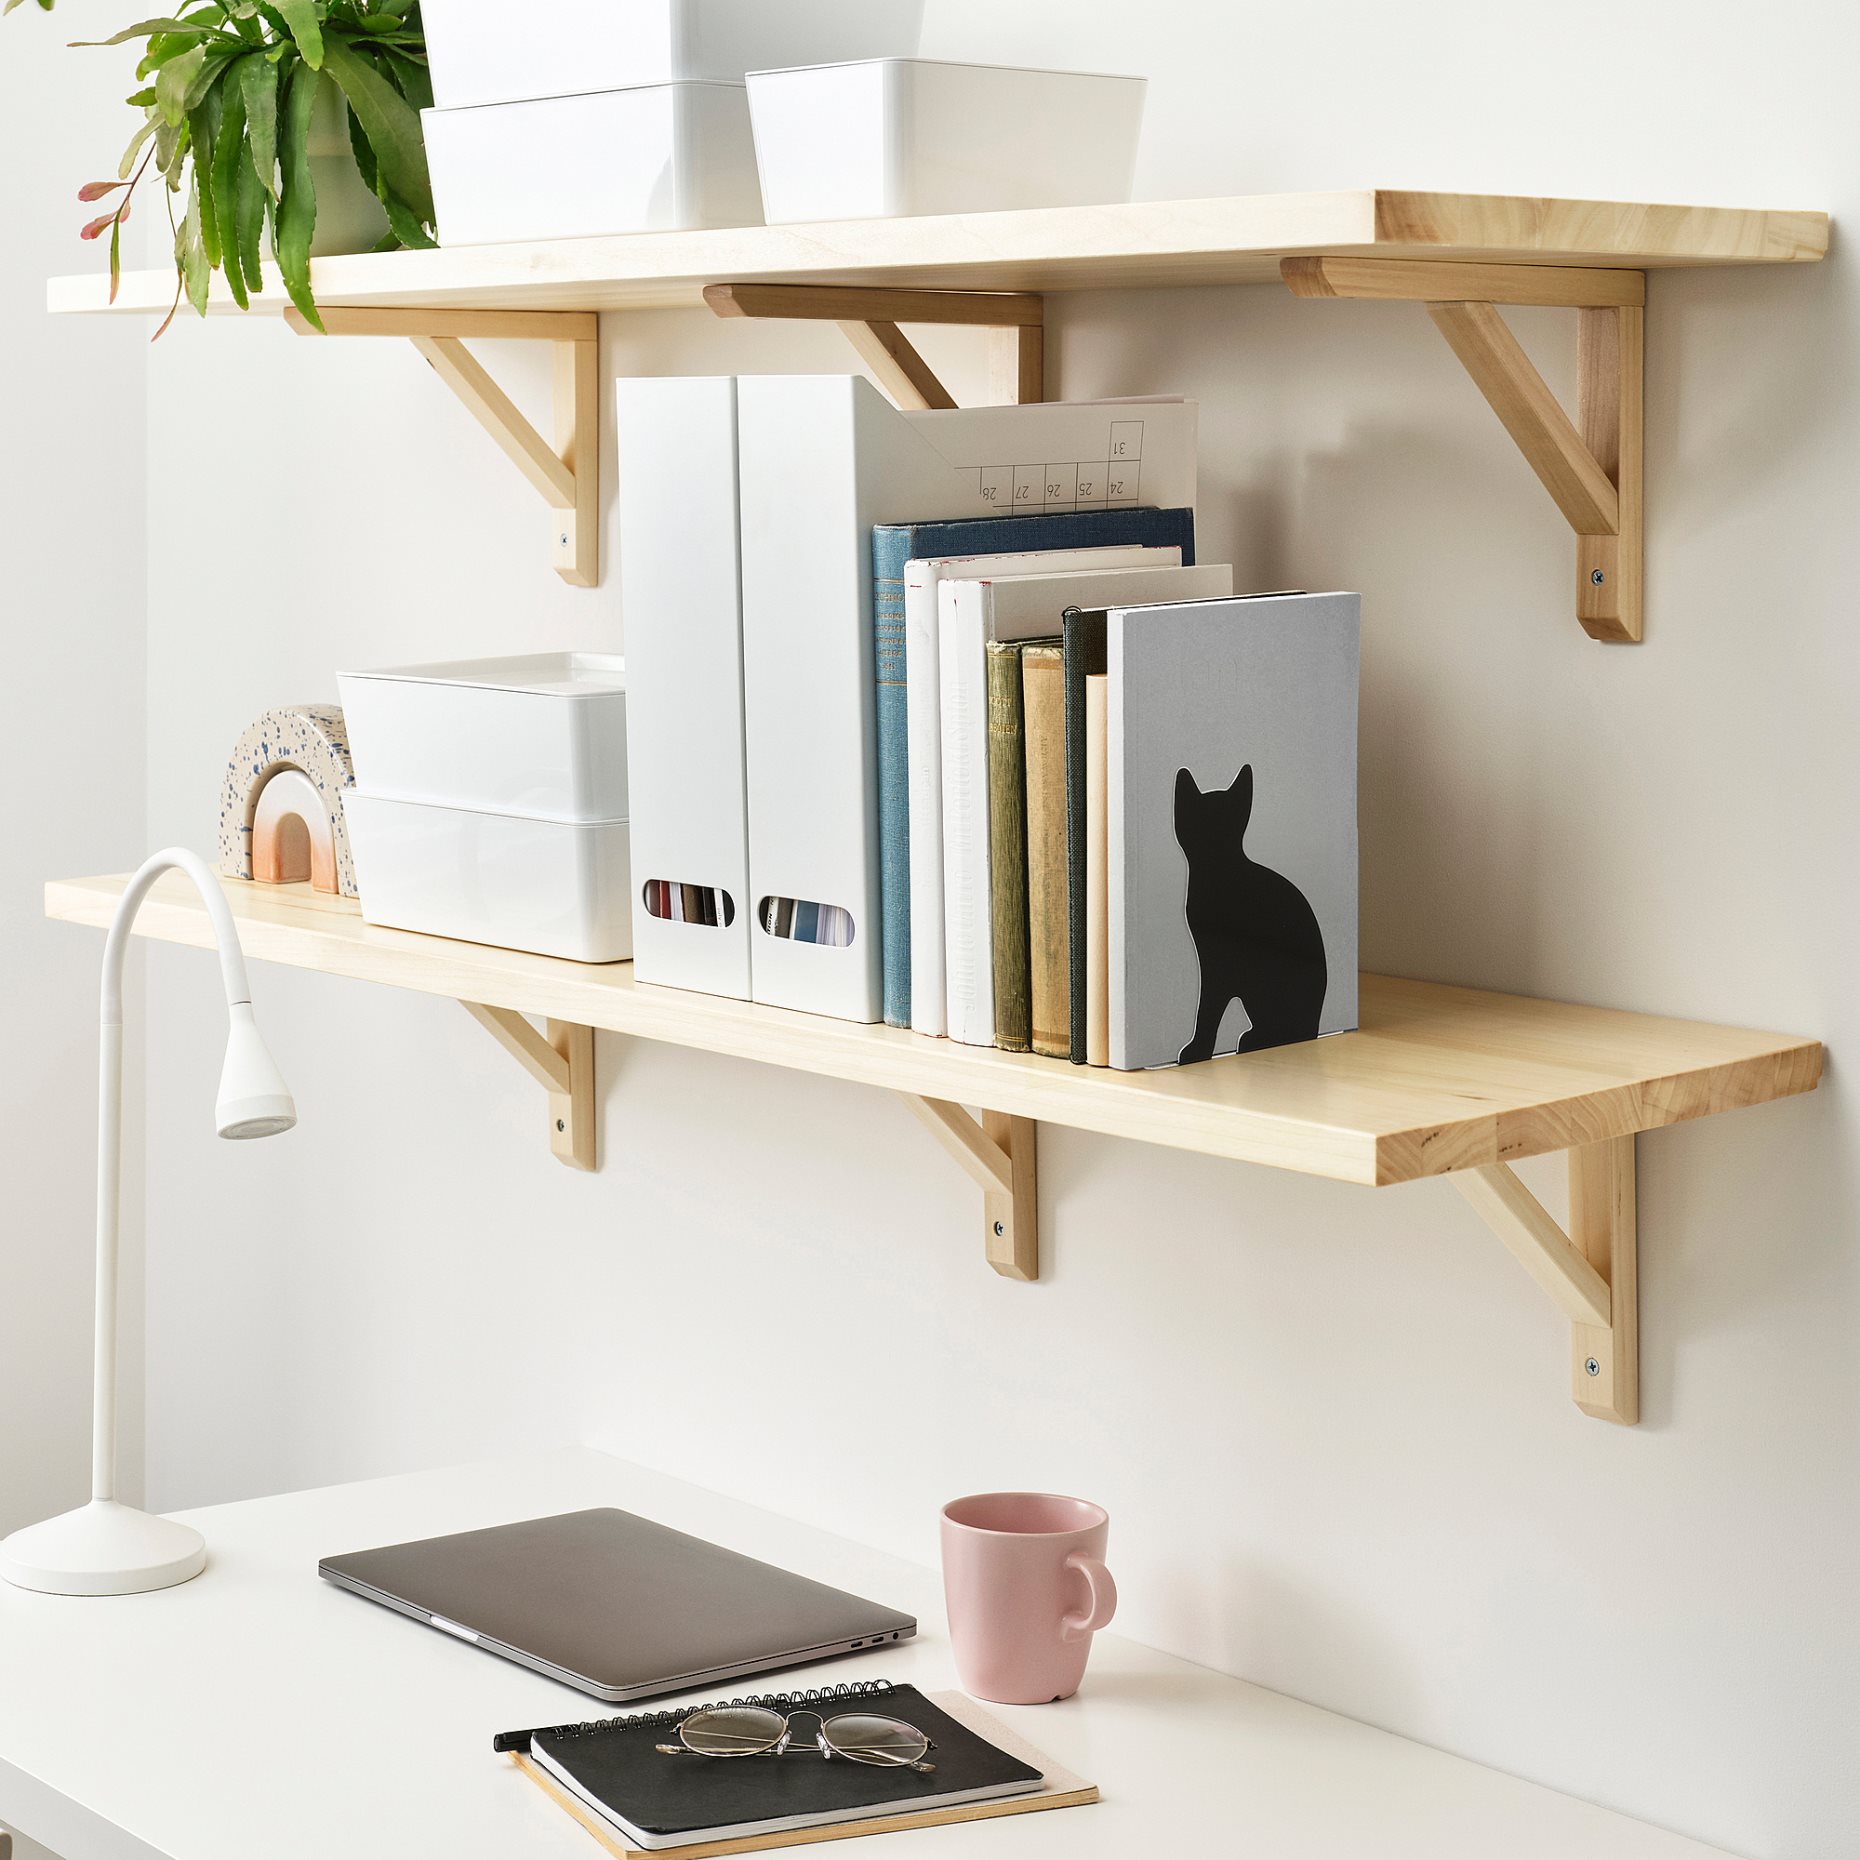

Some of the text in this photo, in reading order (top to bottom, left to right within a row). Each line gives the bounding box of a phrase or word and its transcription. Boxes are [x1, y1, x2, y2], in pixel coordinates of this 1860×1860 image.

[1113, 442, 1126, 455] 31
[982, 481, 1124, 500] 24 25 26 27 28
